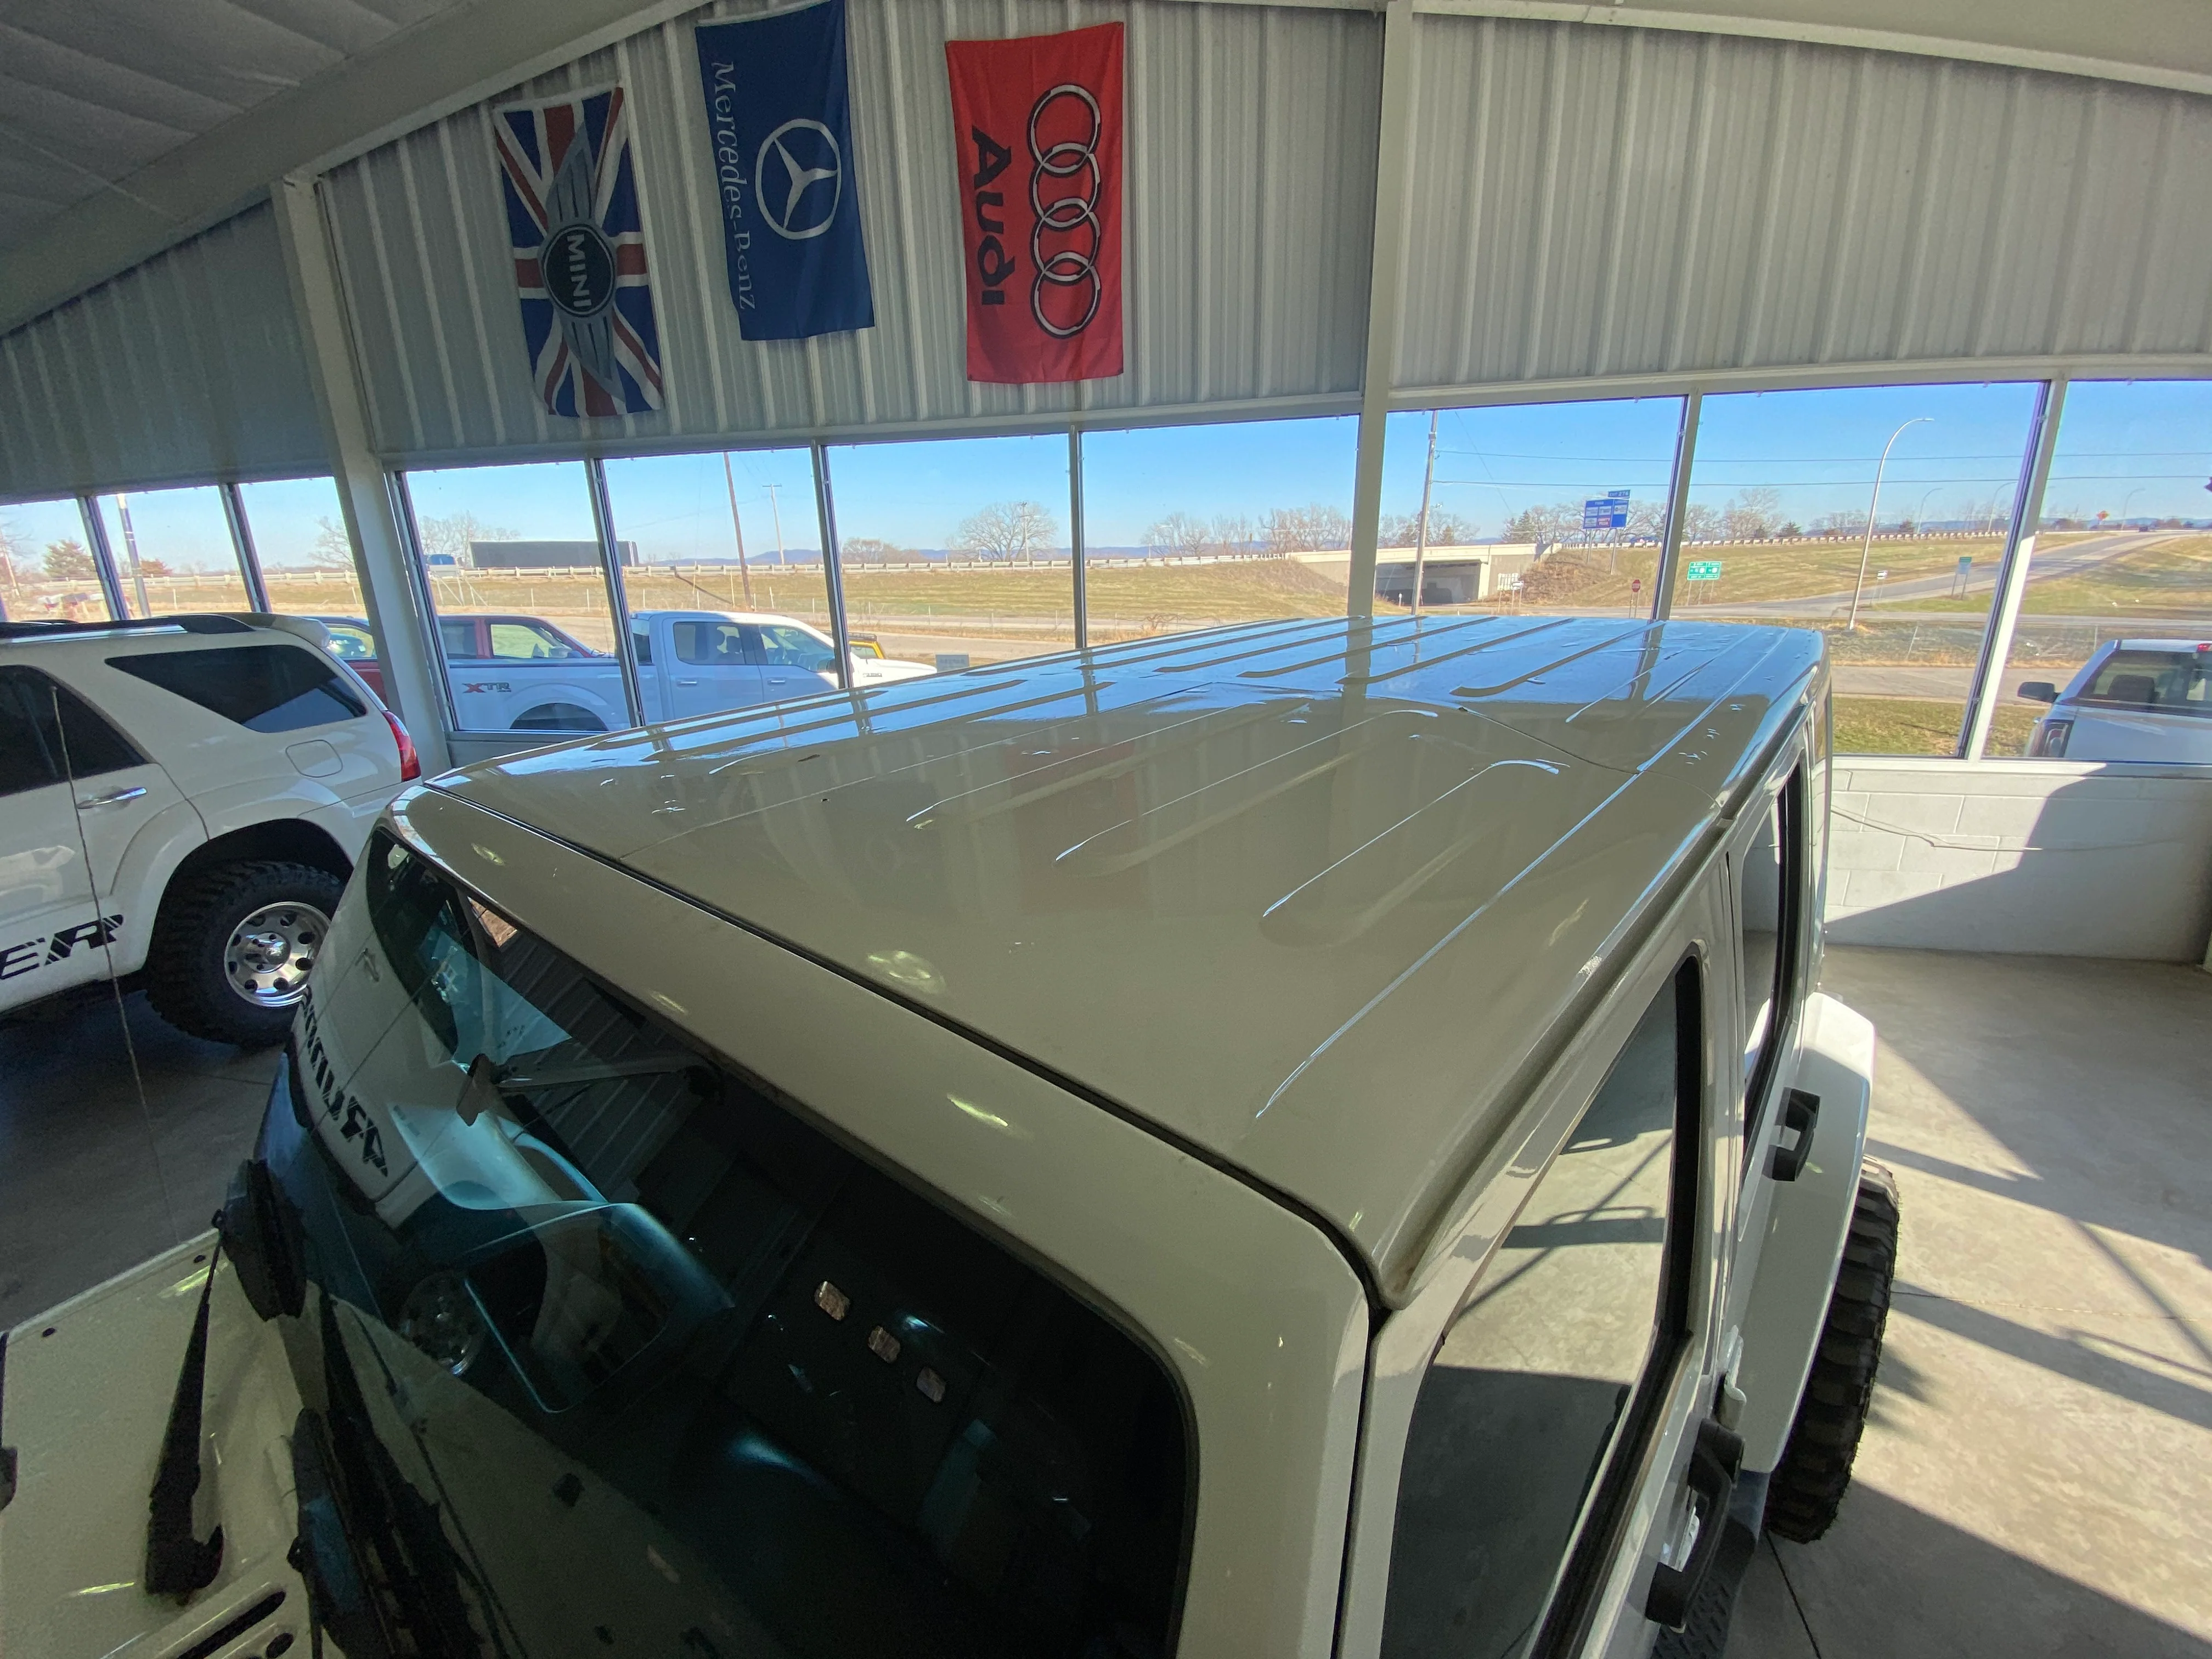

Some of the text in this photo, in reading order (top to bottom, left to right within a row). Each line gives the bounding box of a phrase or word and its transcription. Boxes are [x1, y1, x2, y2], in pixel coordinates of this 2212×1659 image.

[711, 61, 755, 310] Mercedes-Benz
[972, 125, 1015, 305] Audi
[567, 234, 592, 307] MINI
[461, 682, 511, 693] XTR
